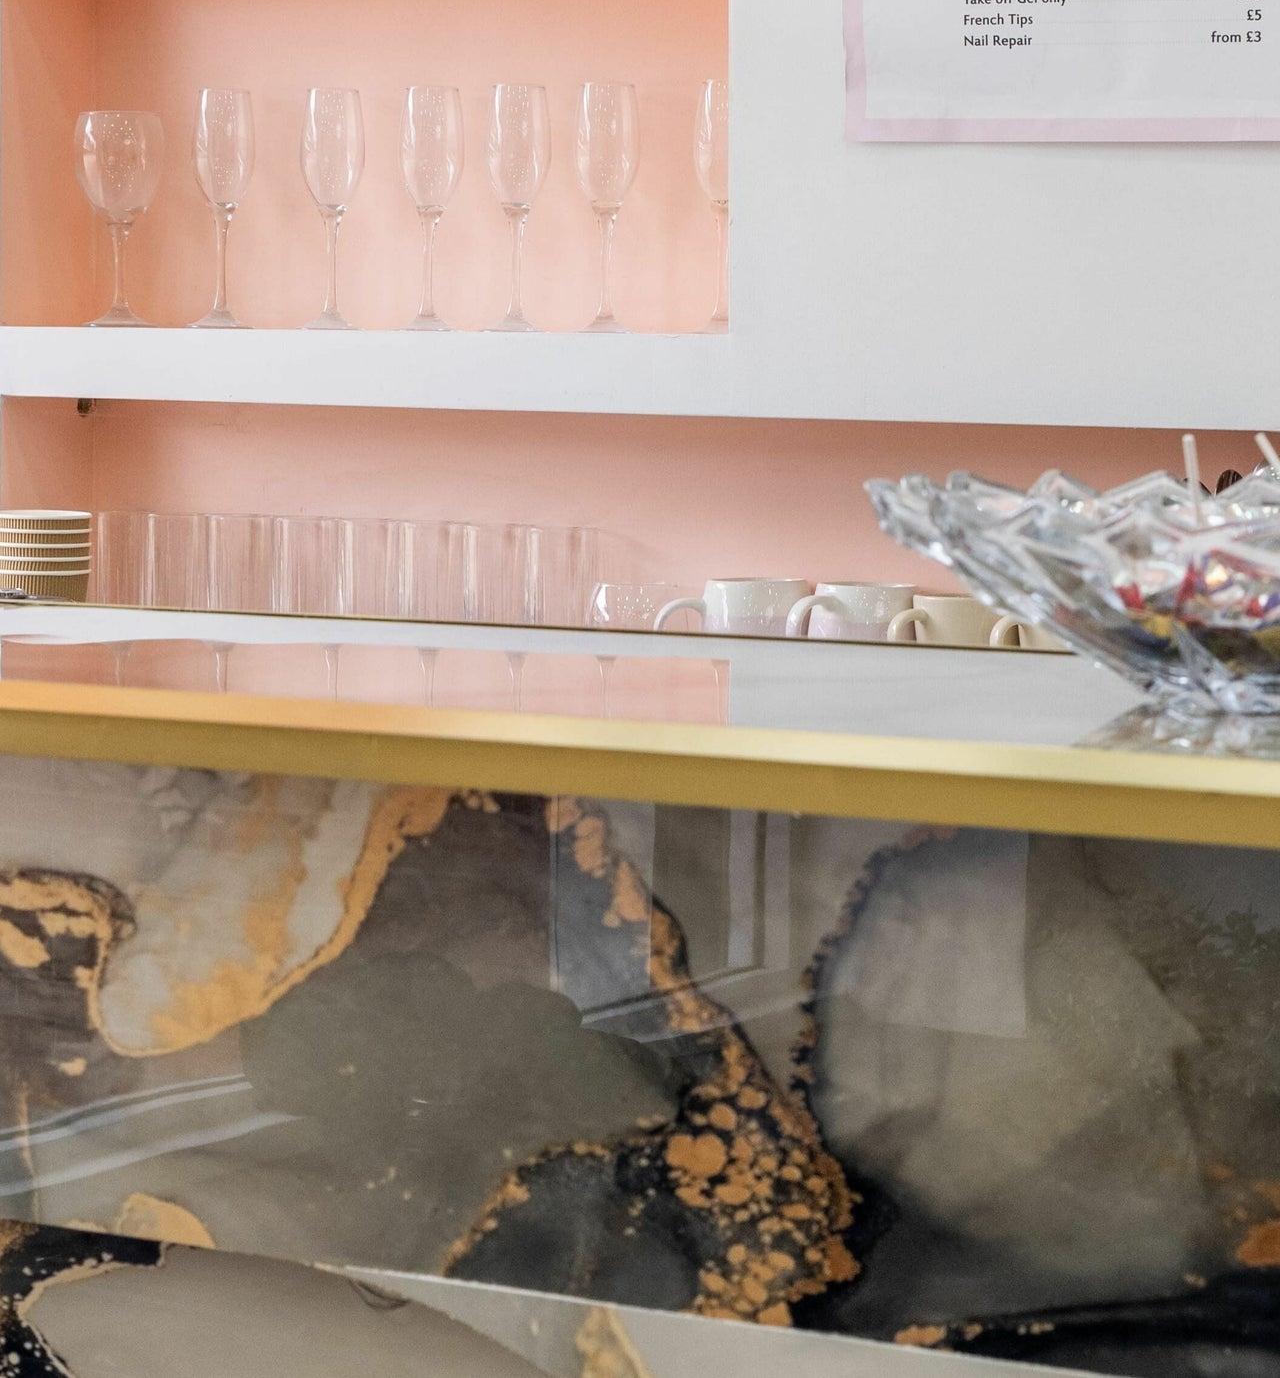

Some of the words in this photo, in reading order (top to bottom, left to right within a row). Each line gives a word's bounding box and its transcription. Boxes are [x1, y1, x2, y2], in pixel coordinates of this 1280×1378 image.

[963, 12, 1005, 26] French
[1007, 13, 1034, 29] Tips
[1246, 8, 1262, 21] £5
[963, 34, 989, 47] Nail
[992, 34, 1033, 50] Repair
[1210, 30, 1242, 43] from
[1246, 30, 1262, 43] £3
